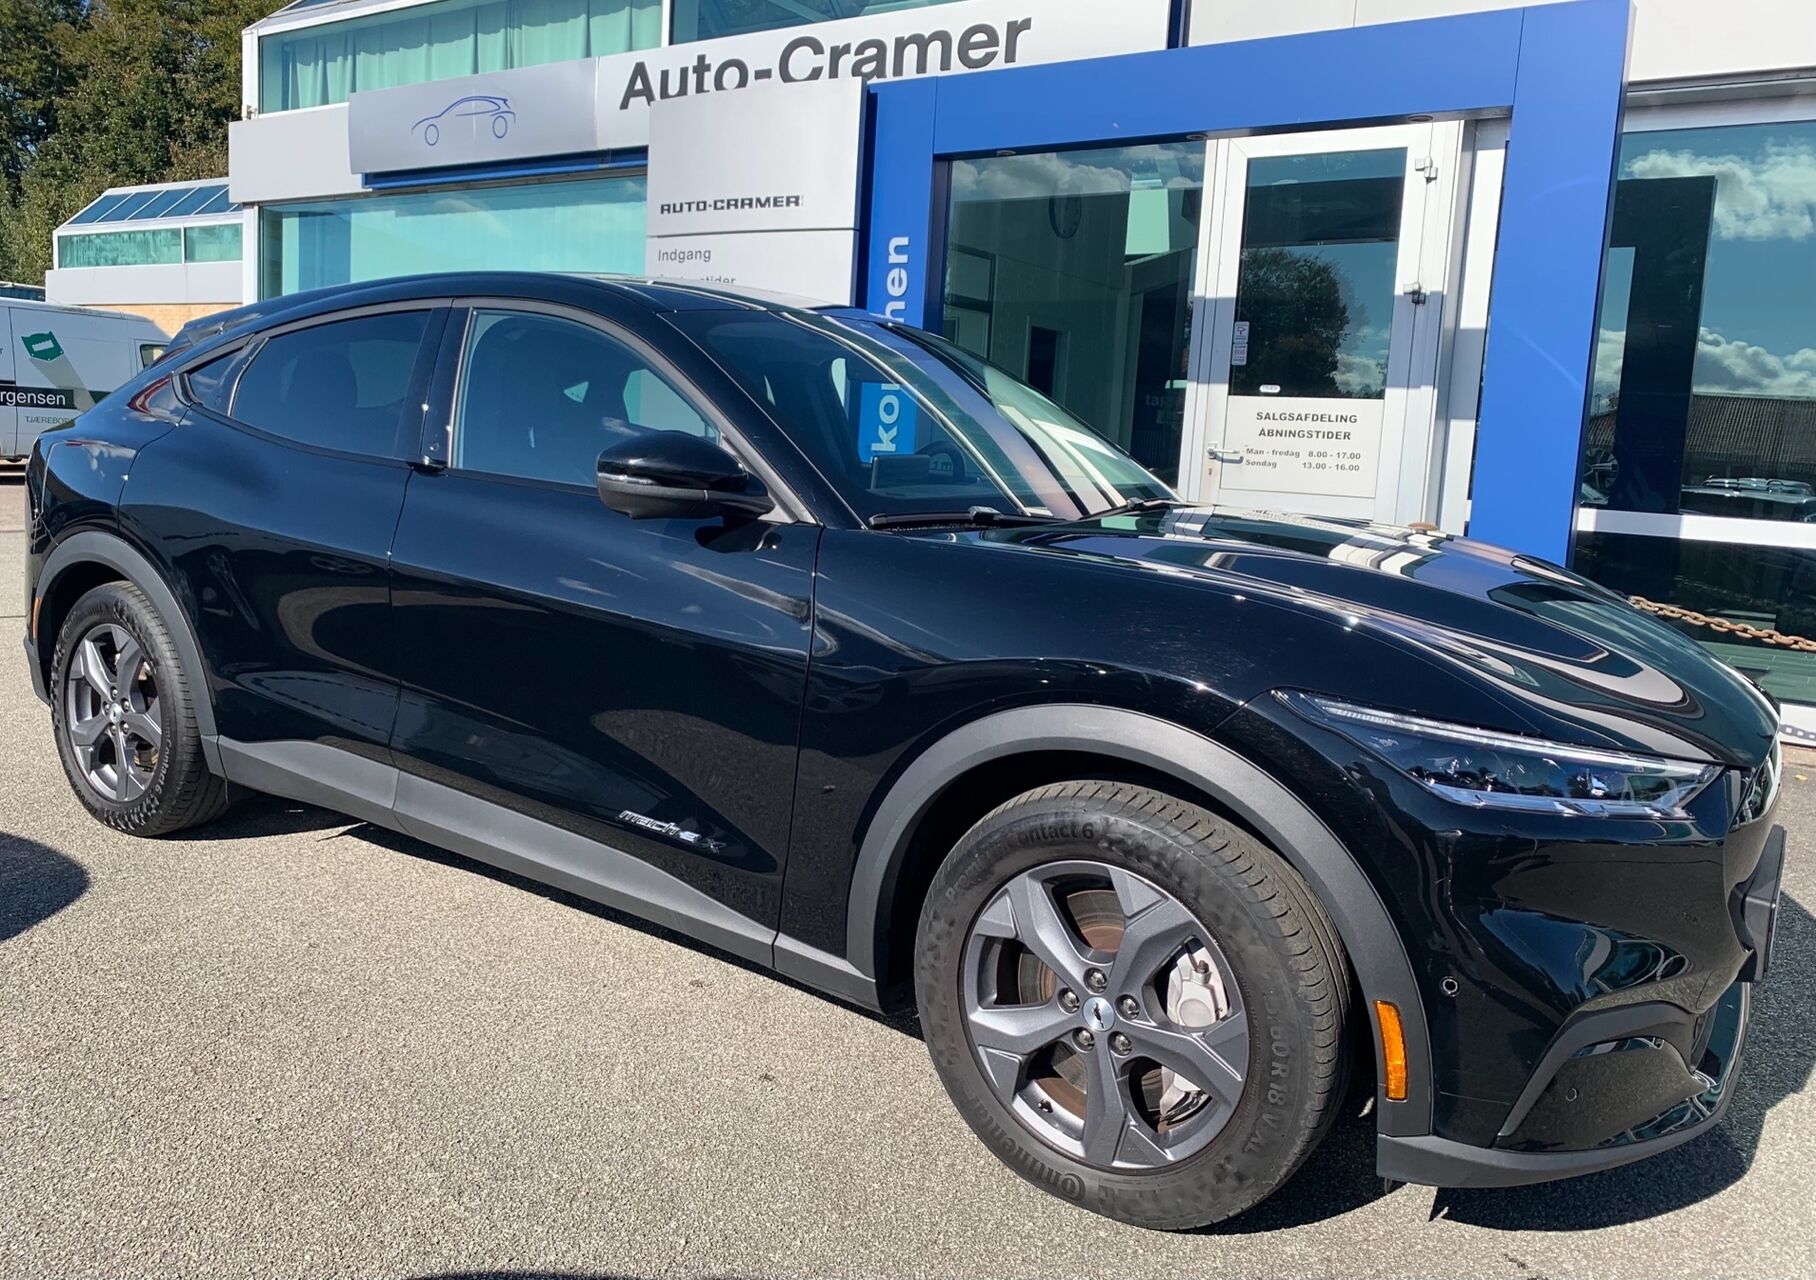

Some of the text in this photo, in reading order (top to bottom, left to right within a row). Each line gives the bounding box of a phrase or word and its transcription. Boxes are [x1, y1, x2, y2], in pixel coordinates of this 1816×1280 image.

[619, 17, 1032, 110] Auto-Cramer
[658, 248, 711, 263] Indgang
[1256, 411, 1358, 424] SALGSAFDELING
[1258, 427, 1351, 440] ÅBNINGSTIDER
[1271, 448, 1300, 458] fredag
[1336, 452, 1361, 460] 17.00
[1245, 459, 1277, 469] Søndag
[1302, 462, 1327, 470] 13.00
[1336, 463, 1360, 472] 16.00
[1081, 822, 1095, 840] 6
